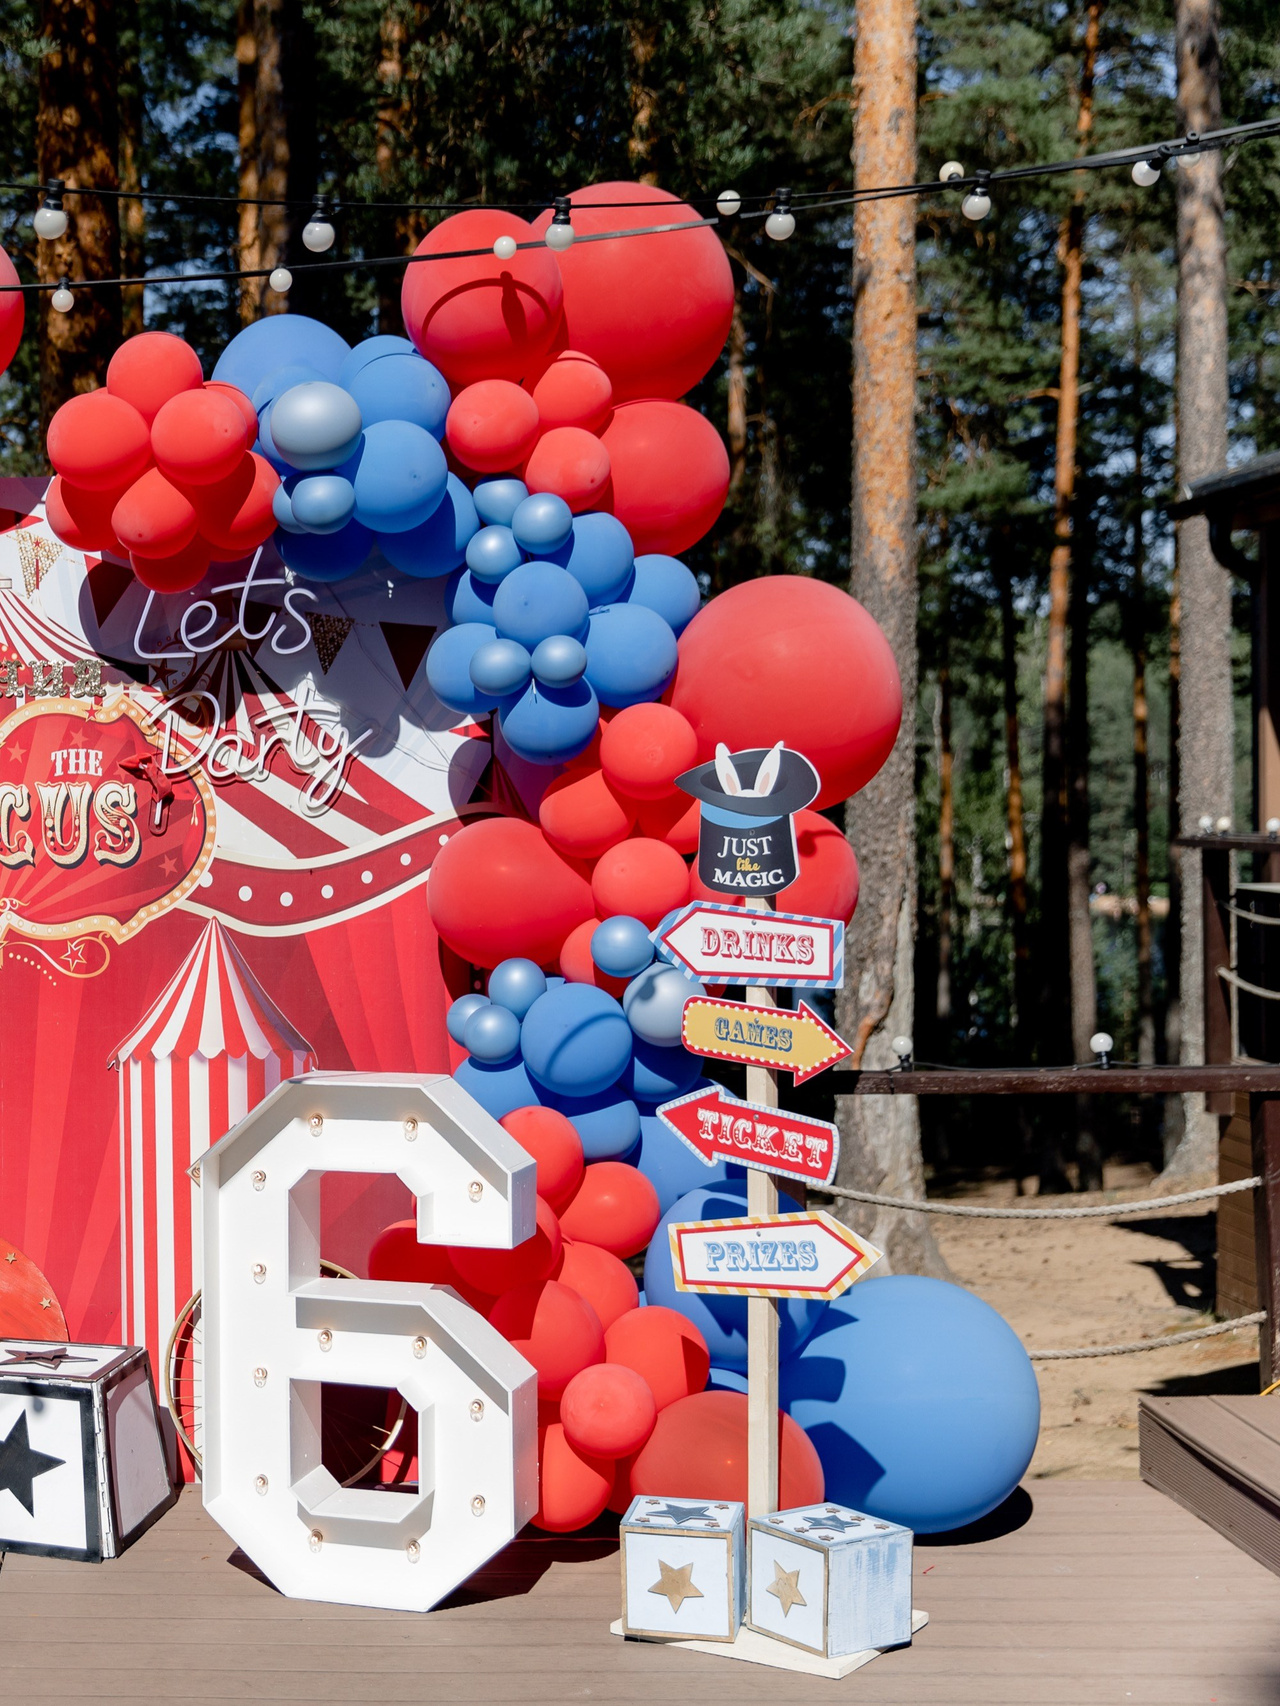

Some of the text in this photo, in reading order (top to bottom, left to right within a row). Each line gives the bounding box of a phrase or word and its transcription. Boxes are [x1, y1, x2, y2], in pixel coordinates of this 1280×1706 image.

[51, 749, 103, 777] THE
[146, 676, 374, 826] Party
[717, 836, 772, 858] JUST
[712, 869, 784, 887] MAGIC
[736, 857, 761, 871] like
[700, 927, 815, 965] DRINKS
[714, 1017, 793, 1052] GAMES
[697, 1108, 828, 1168] TICKET
[704, 1241, 819, 1271] PRIZES
[202, 1071, 538, 1612] 6
